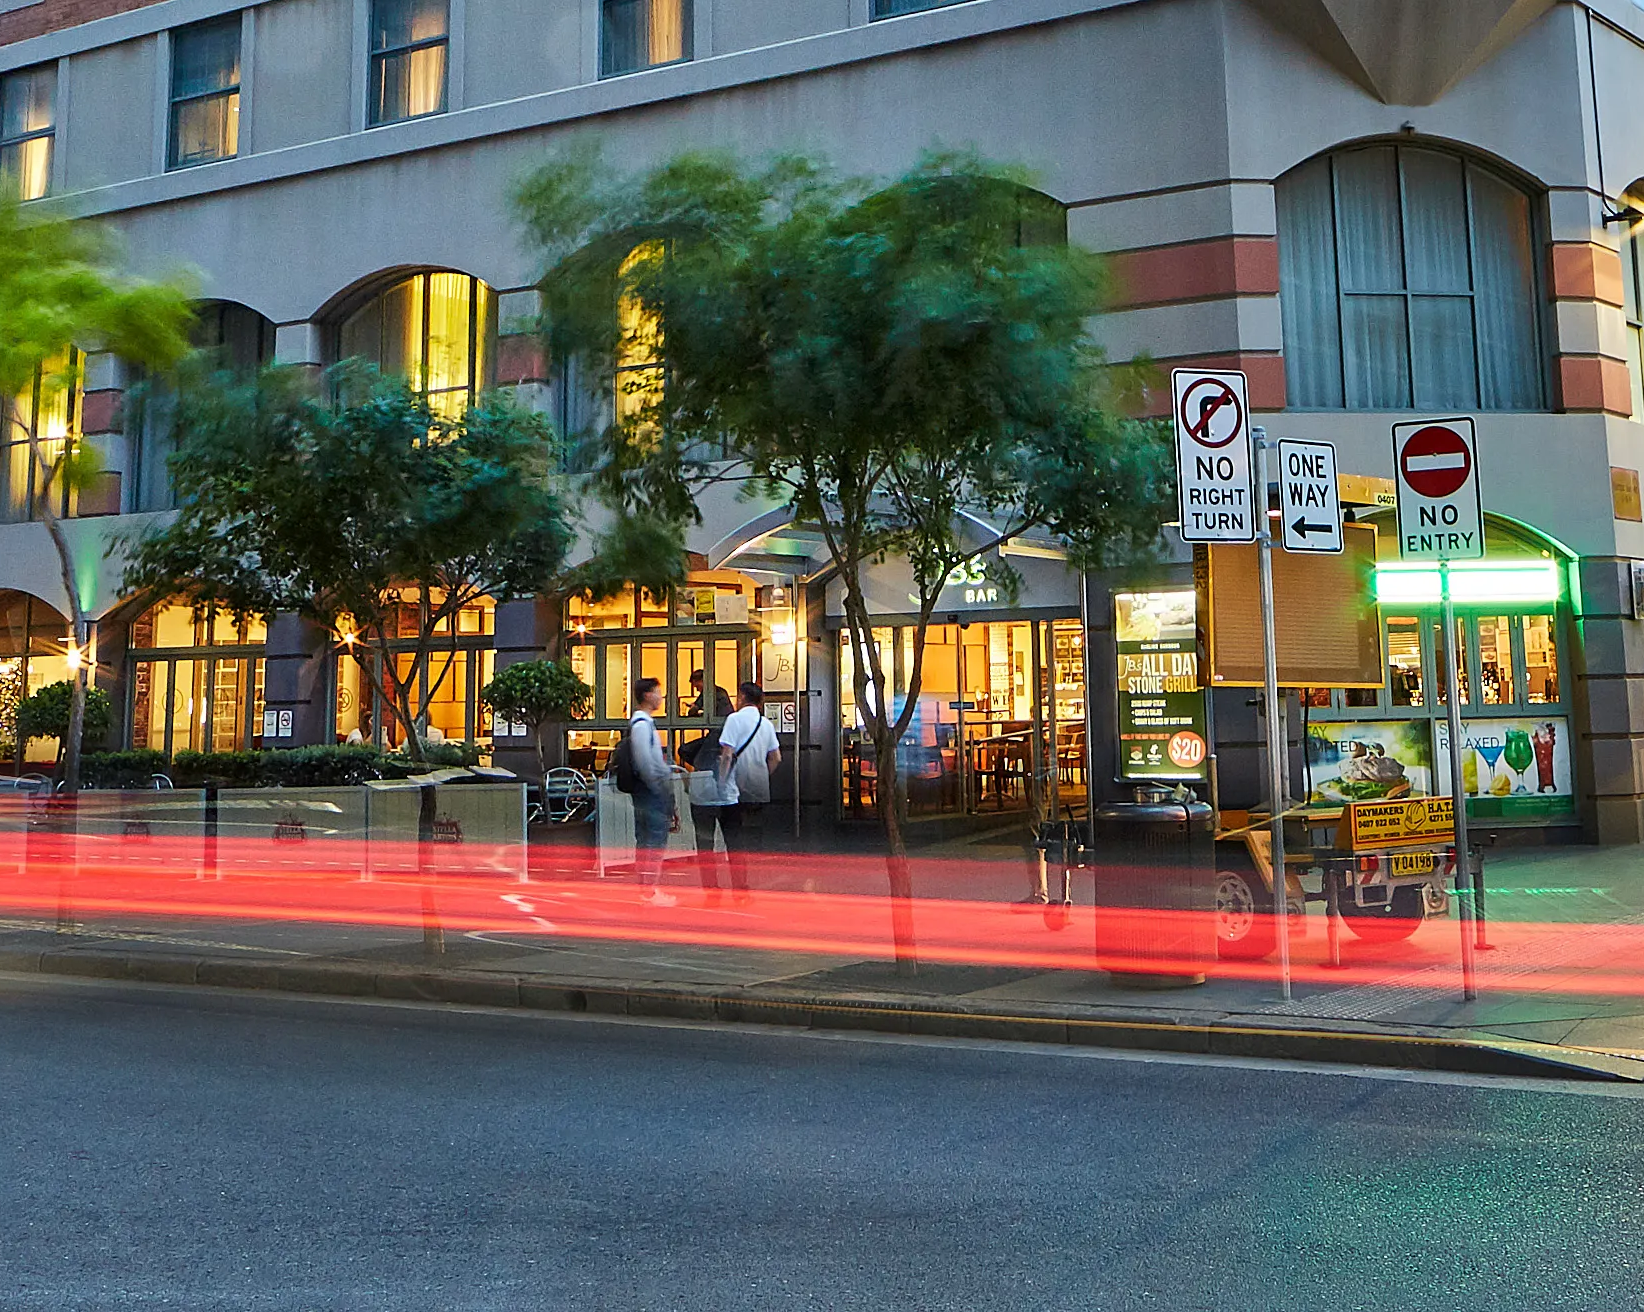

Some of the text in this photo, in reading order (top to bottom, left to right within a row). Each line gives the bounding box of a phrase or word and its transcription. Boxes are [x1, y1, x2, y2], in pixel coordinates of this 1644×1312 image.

[1196, 456, 1234, 481] NO
[1289, 453, 1327, 479] ONE
[1190, 488, 1245, 506] RIGHT
[1289, 482, 1329, 508] WAY
[1377, 495, 1395, 505] 0407
[1192, 512, 1244, 530] TURN
[1419, 504, 1459, 527] NO
[1407, 532, 1474, 553] ENTRY
[965, 589, 998, 604] BAR
[1142, 654, 1168, 676] ALL
[1128, 675, 1198, 694] STONE GRILL
[1171, 736, 1201, 761] $20
[1357, 806, 1404, 817] DAYMAKERS
